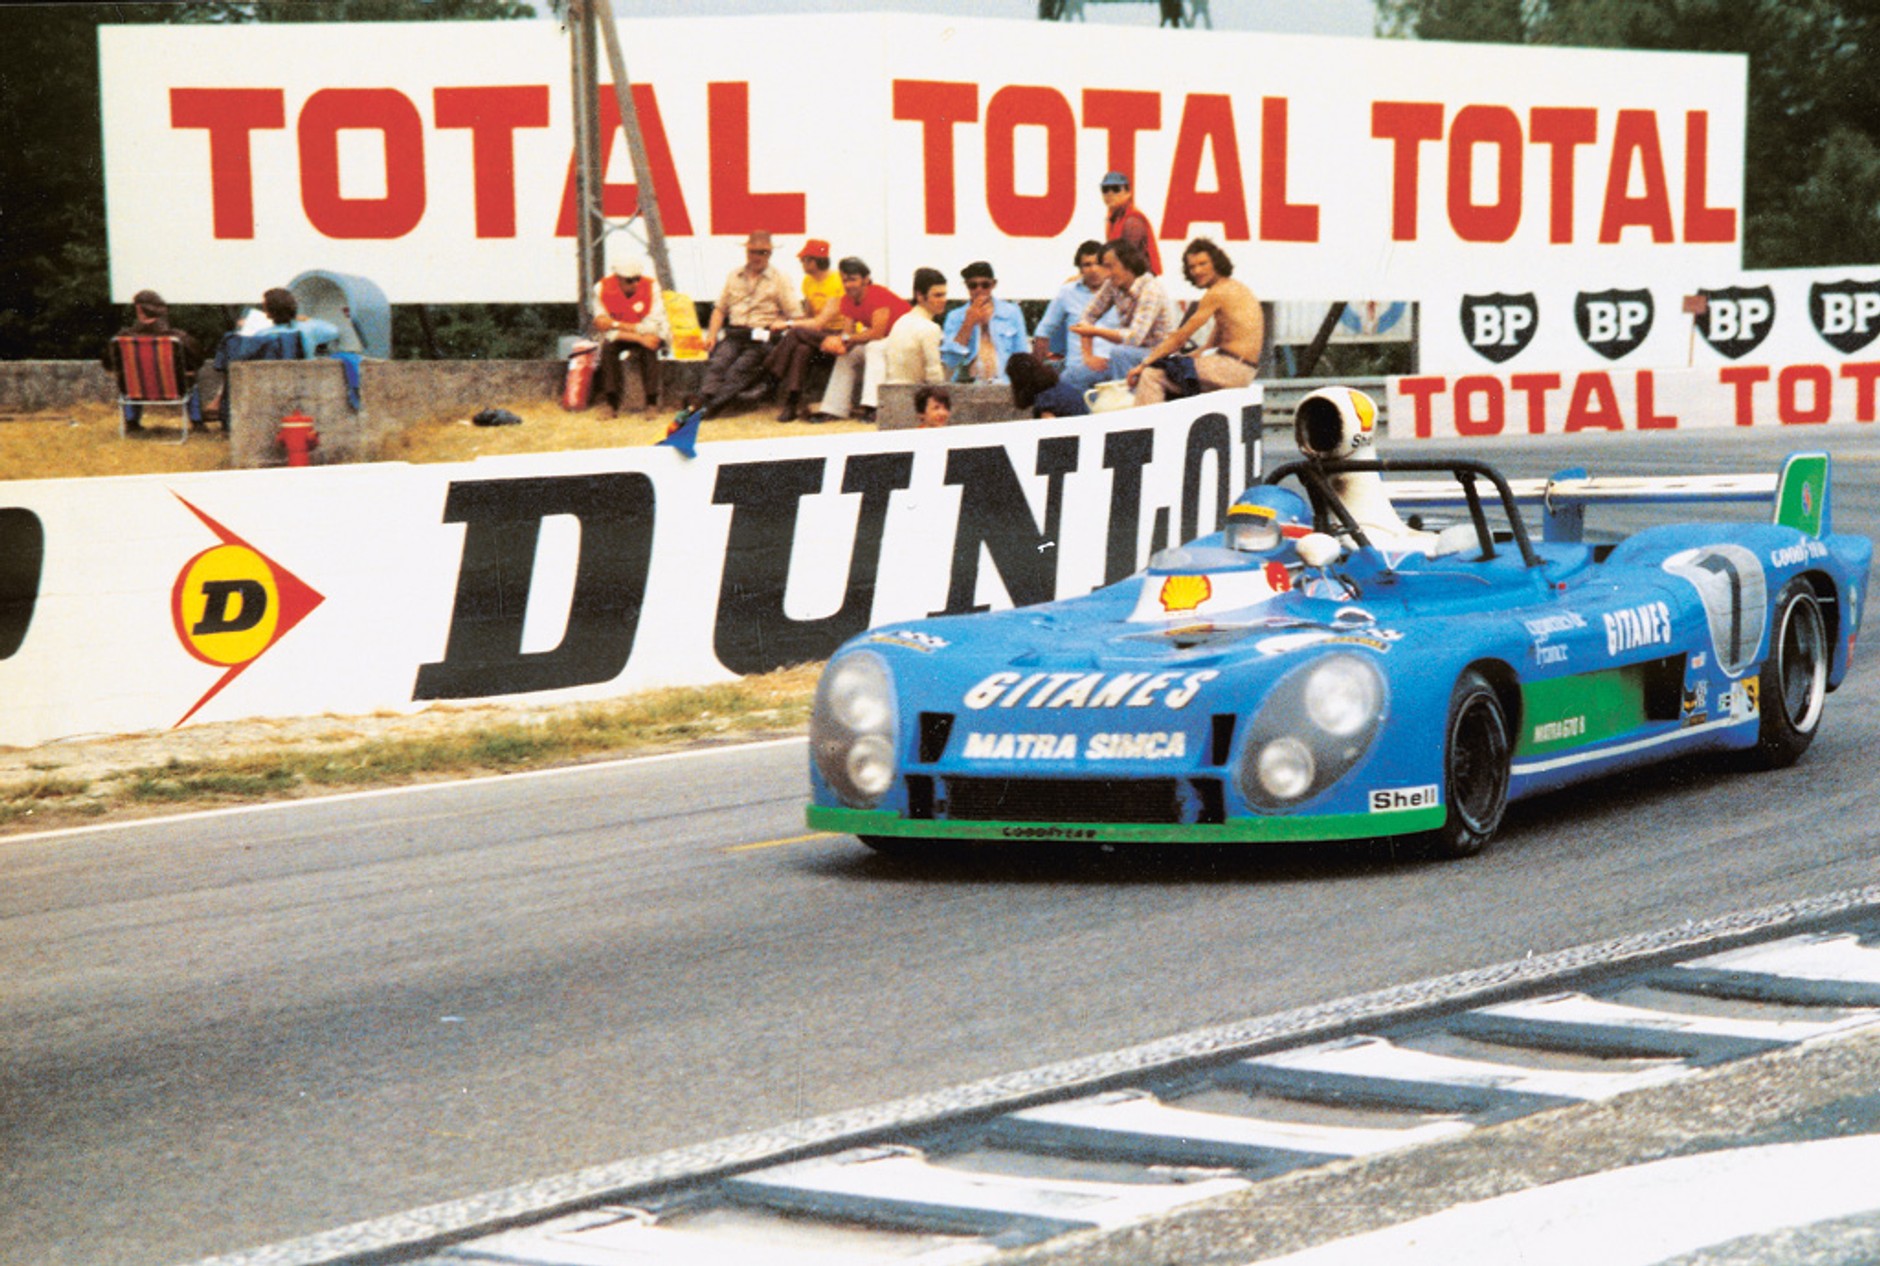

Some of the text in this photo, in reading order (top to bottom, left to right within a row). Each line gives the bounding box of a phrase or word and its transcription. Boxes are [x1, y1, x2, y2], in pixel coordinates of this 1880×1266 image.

[168, 82, 806, 240] TOTAL
[892, 79, 1736, 244] TOTAL TOTAL
[1472, 305, 1532, 346] BP
[1586, 301, 1648, 342] BP
[1708, 298, 1770, 341] BP
[1821, 293, 1880, 334] BP
[1399, 361, 1880, 439] TOTAL TOT
[1603, 601, 1672, 656] GITANES
[963, 670, 1220, 709] GITANES
[963, 731, 1186, 760] MATRA SIMCA
[1374, 788, 1436, 809] Shell
